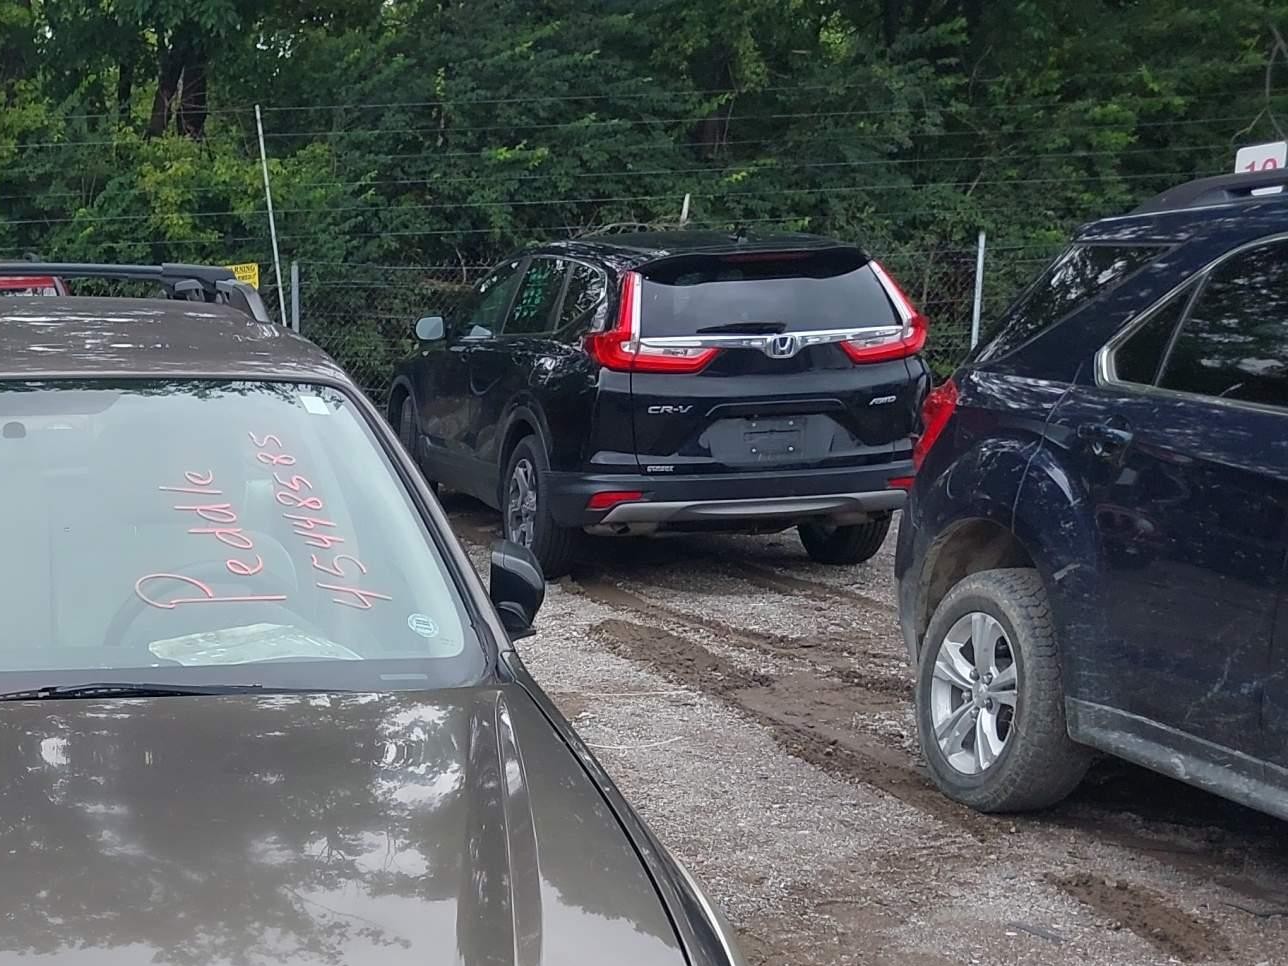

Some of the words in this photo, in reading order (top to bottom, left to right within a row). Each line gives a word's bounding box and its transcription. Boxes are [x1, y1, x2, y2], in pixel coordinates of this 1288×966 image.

[647, 405, 694, 414] CR-V
[134, 470, 287, 610] Peddle
[248, 431, 393, 610] 45448585
